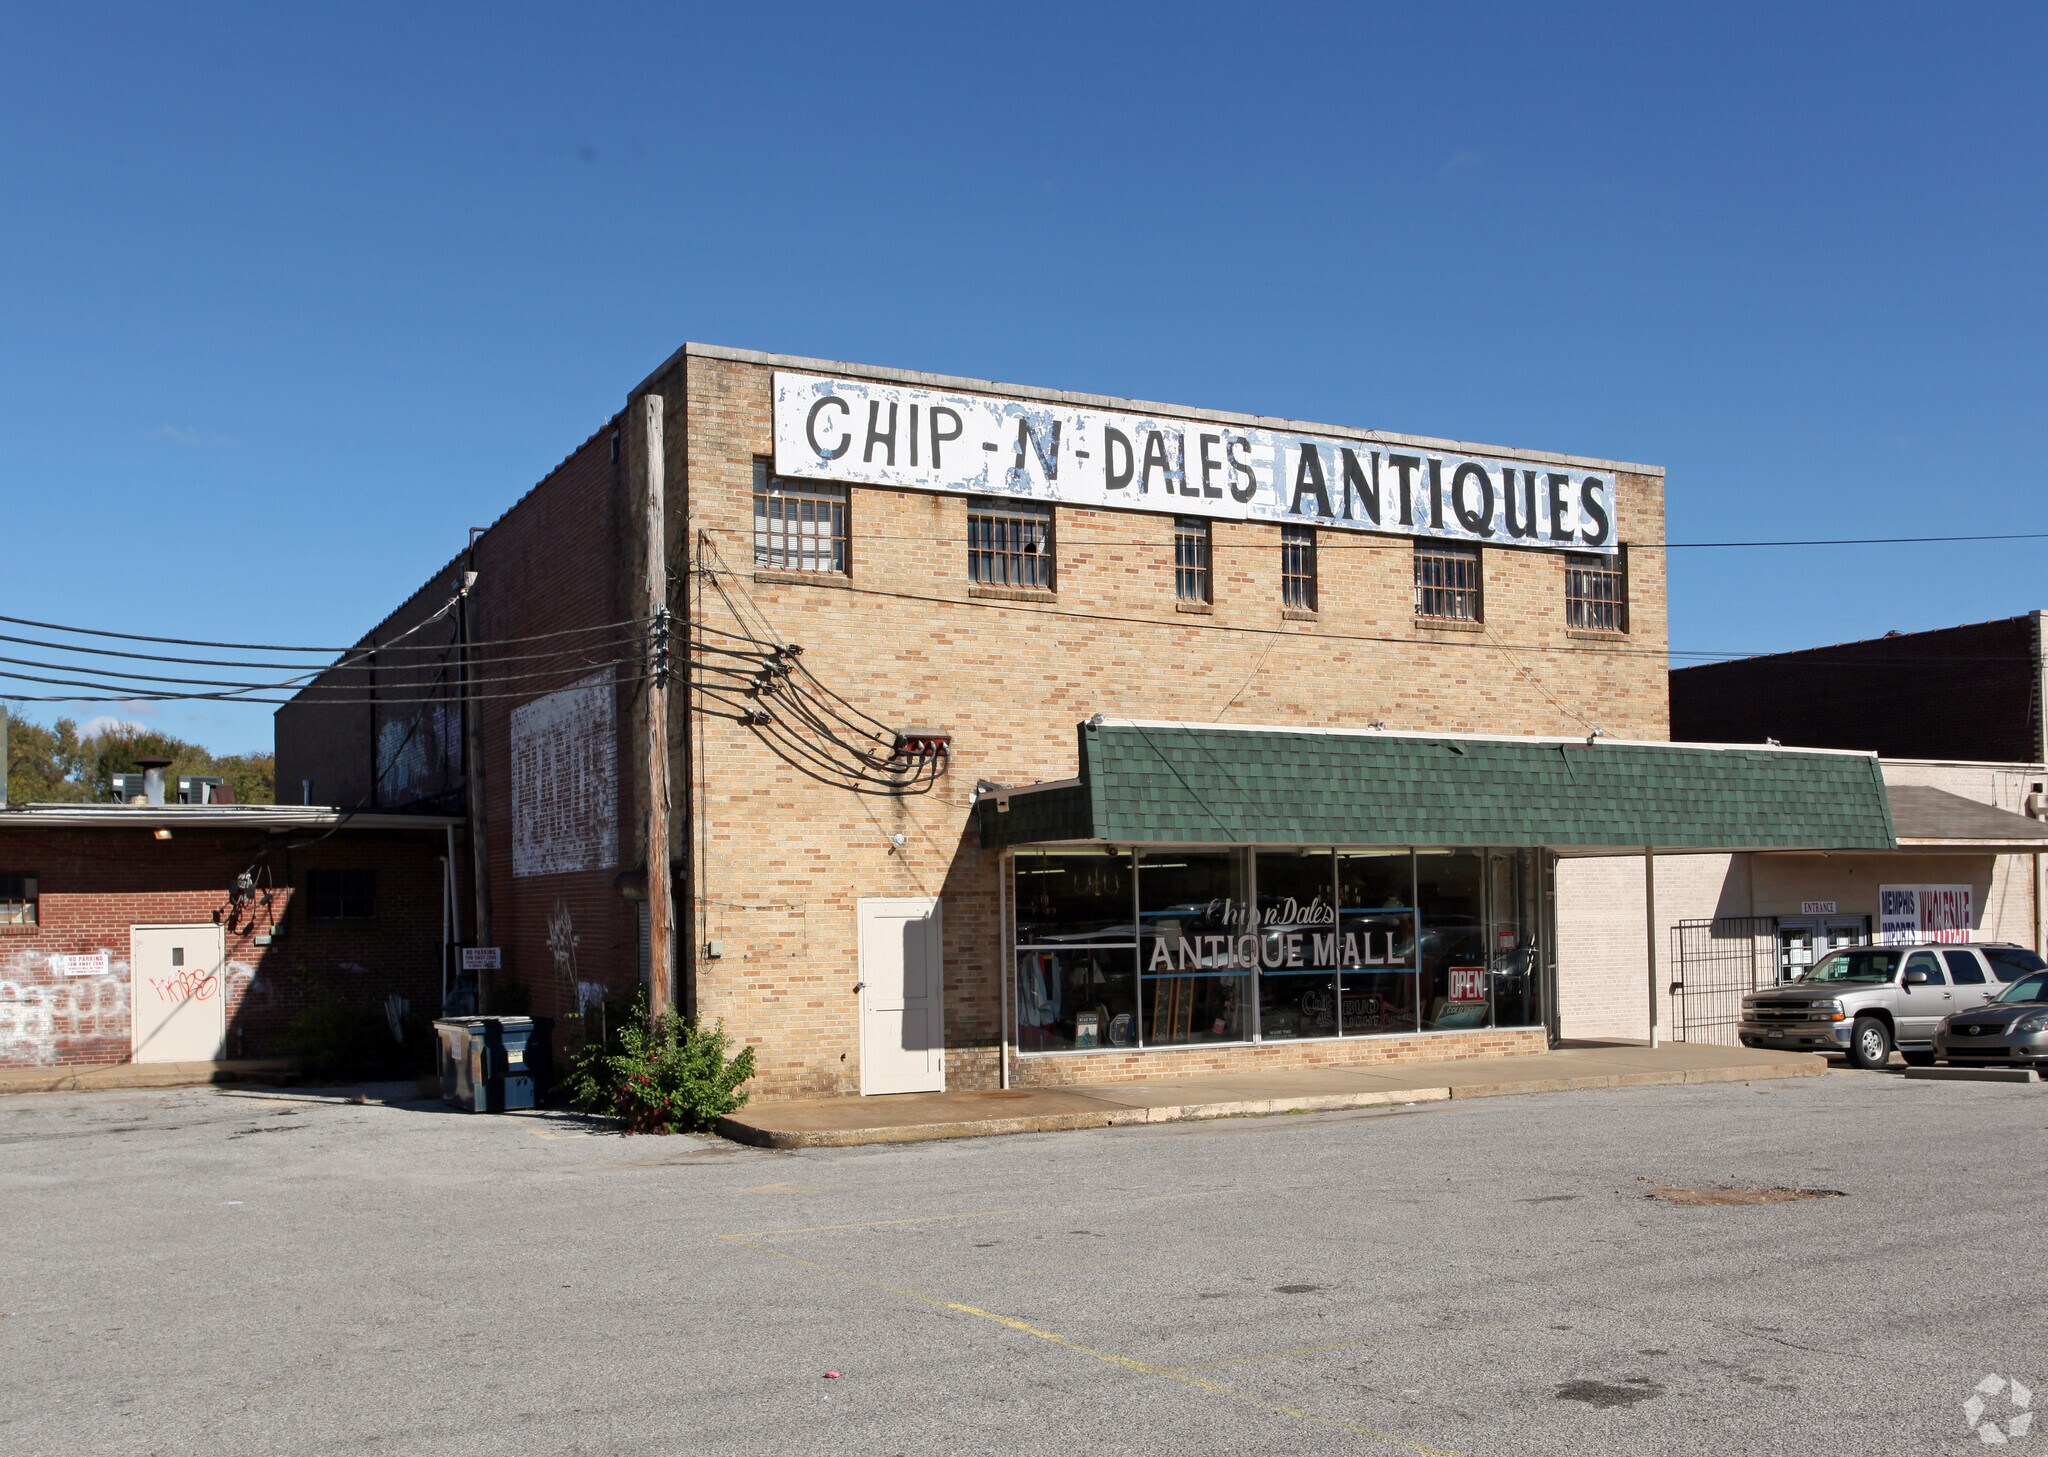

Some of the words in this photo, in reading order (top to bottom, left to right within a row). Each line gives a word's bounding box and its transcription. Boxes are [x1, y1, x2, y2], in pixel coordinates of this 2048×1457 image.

[1288, 441, 1610, 546] ANTIQUES
[1804, 902, 1835, 913] ENTRANCE
[1881, 890, 1915, 916] MEMPHIS
[1918, 890, 1970, 945] WHOLESALE
[1882, 921, 1916, 946] IMPORTS
[1147, 932, 1305, 975] ANTIQUE
[1311, 931, 1406, 967] MALL
[1450, 970, 1484, 999] OPEN
[1301, 990, 1333, 1016] Colt
[1342, 999, 1380, 1016] BUD
[1315, 1011, 1334, 1028] 45
[1342, 1015, 1380, 1028] LIGHT
